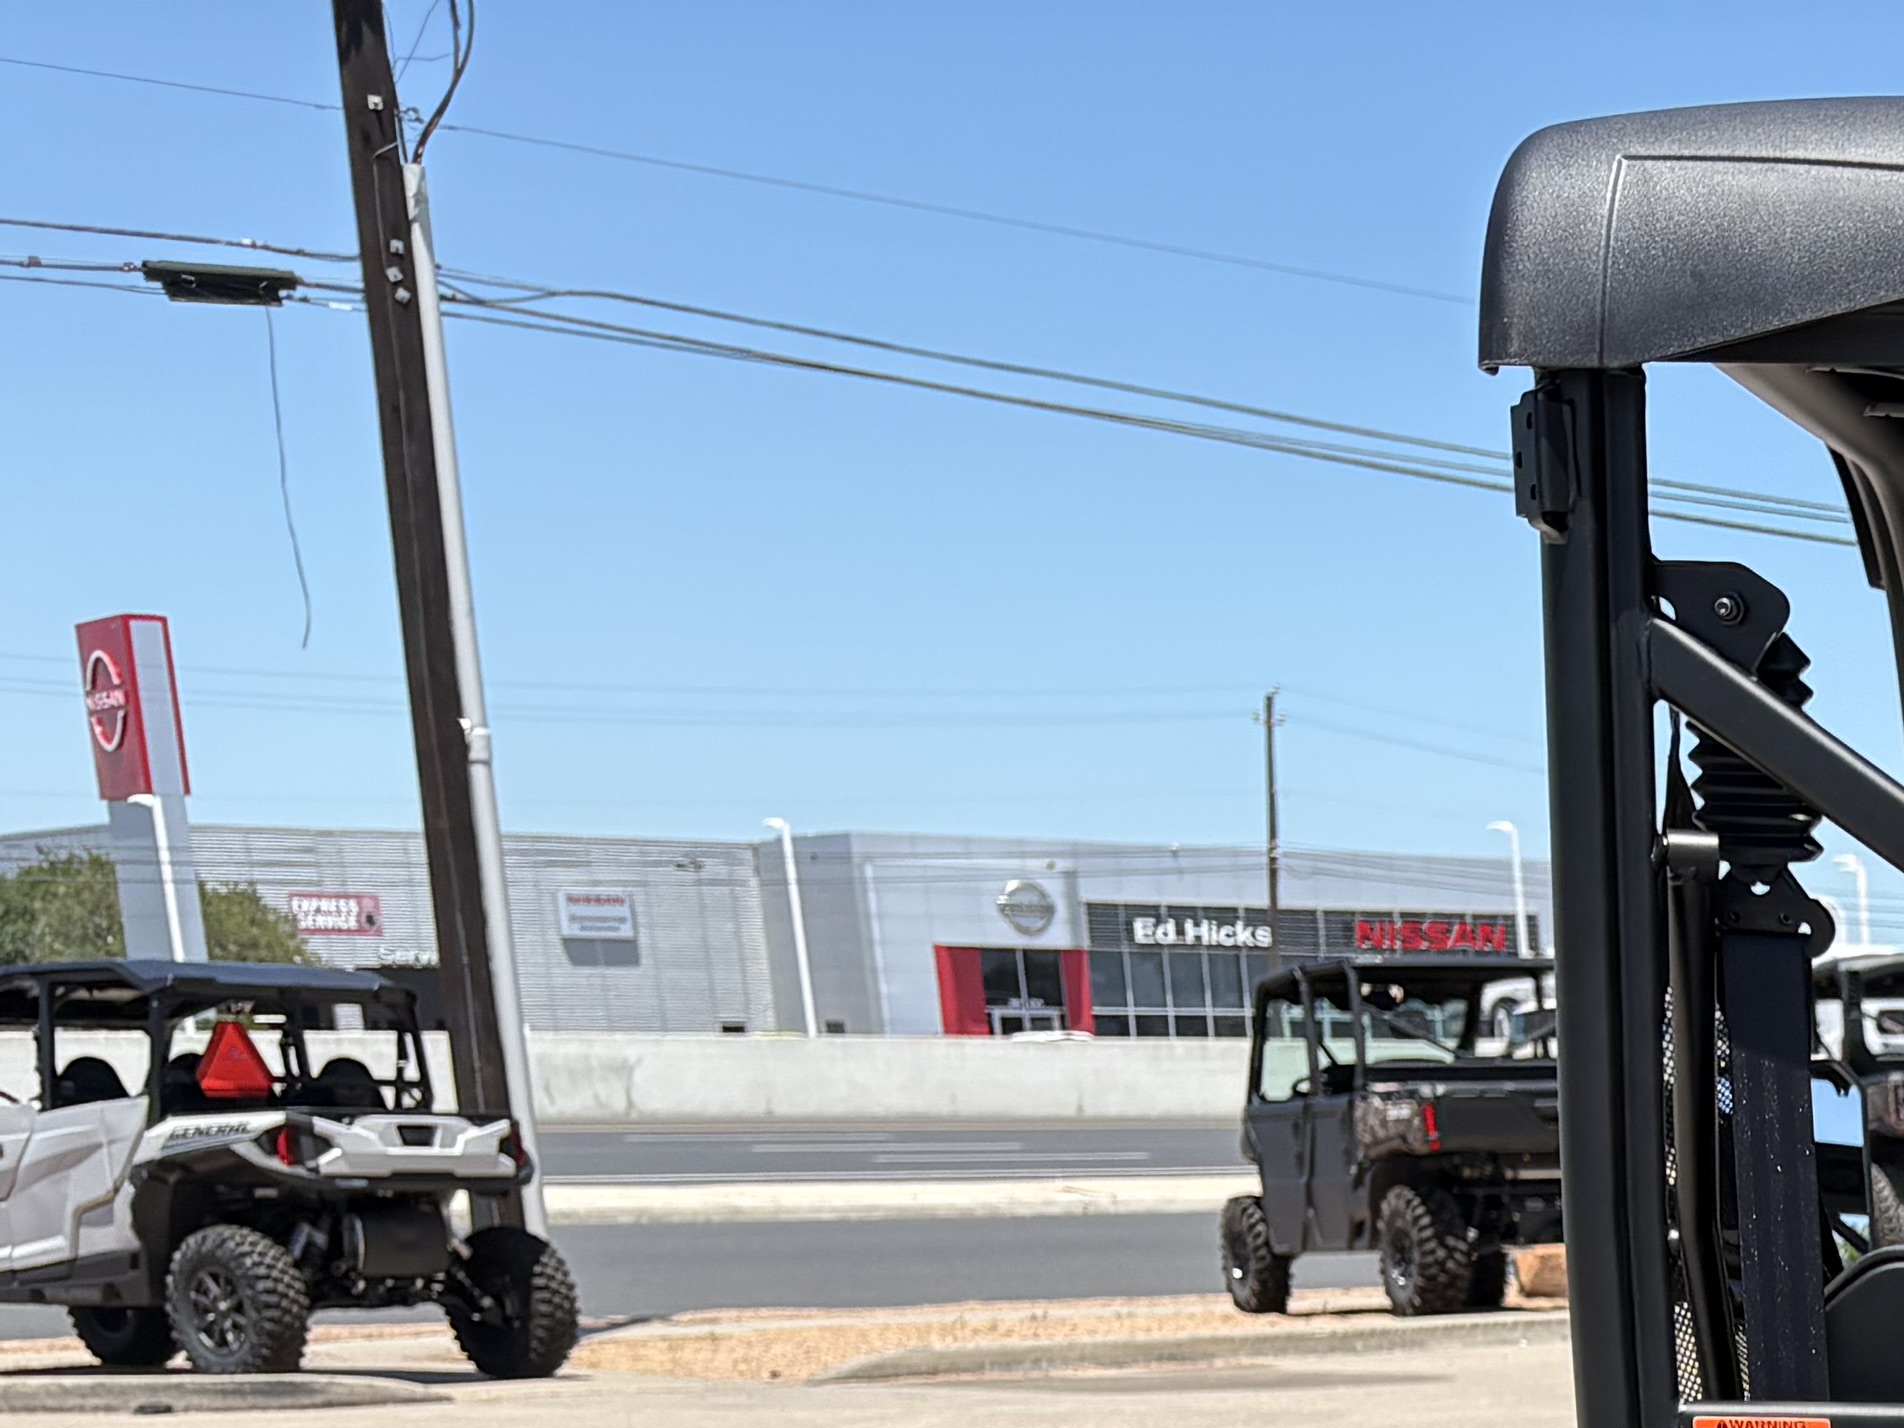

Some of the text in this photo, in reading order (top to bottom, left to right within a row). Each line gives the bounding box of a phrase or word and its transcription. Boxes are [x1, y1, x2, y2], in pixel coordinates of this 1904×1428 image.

[291, 895, 359, 913] EXPRESS
[297, 913, 359, 930] SERVICE
[1133, 917, 1273, 947] Ed Hicks
[1356, 919, 1506, 951] NISSAN
